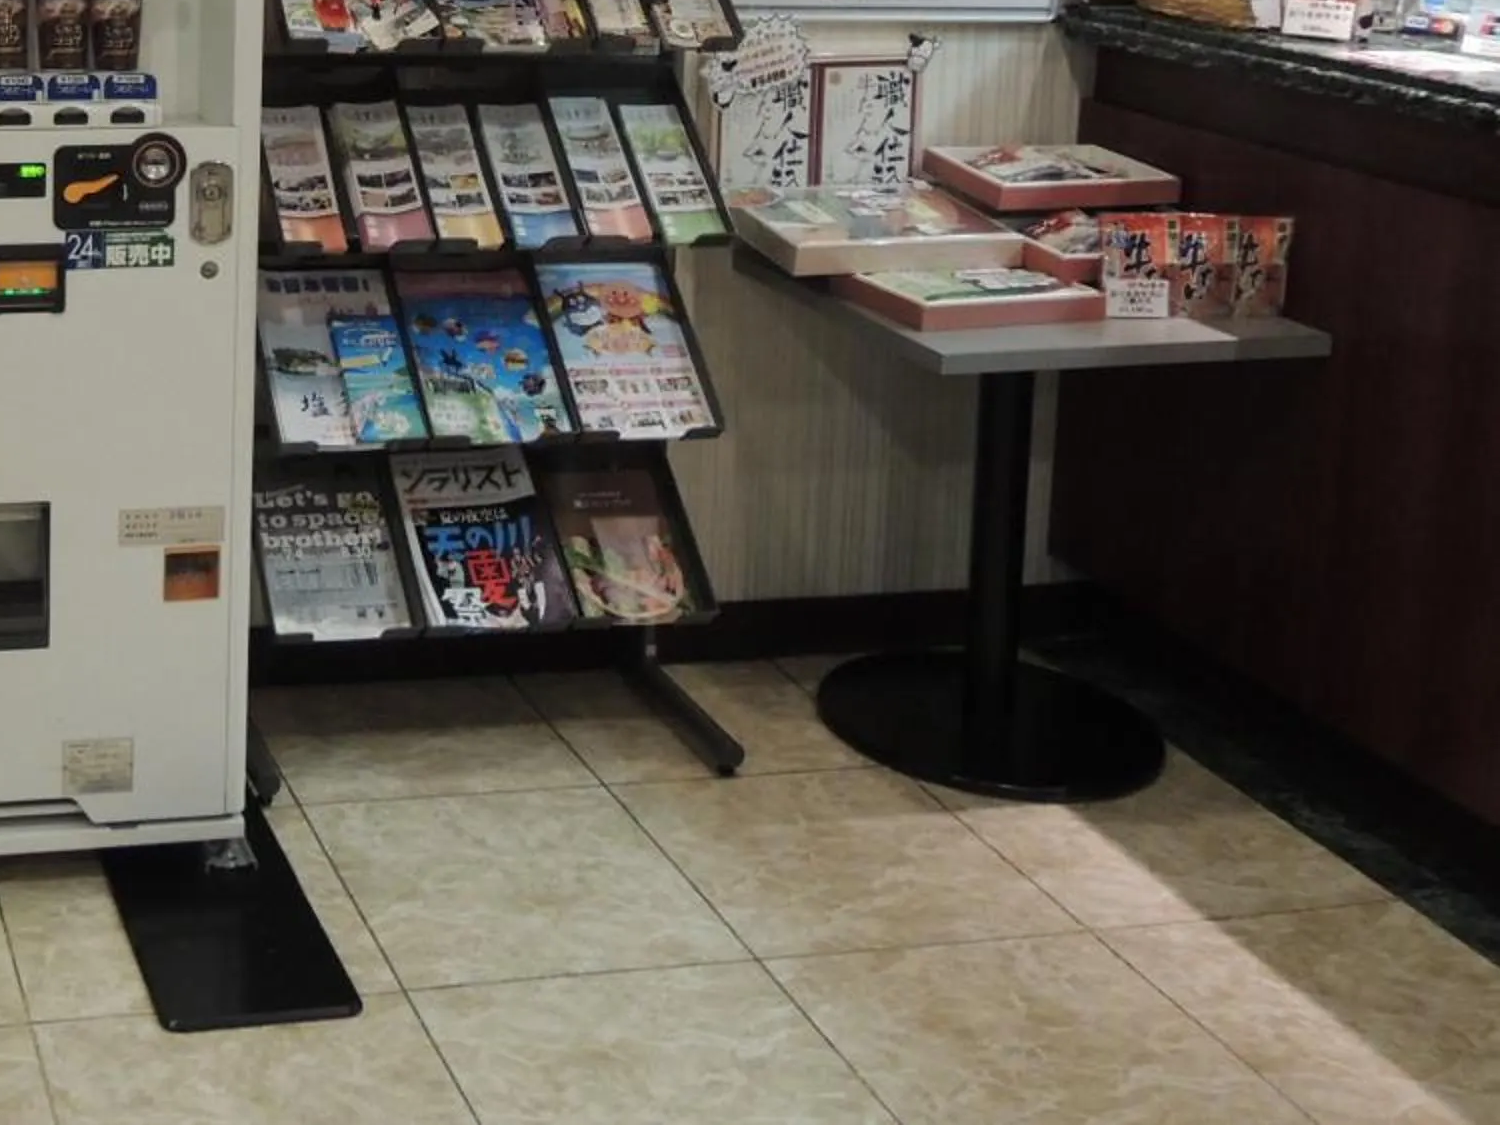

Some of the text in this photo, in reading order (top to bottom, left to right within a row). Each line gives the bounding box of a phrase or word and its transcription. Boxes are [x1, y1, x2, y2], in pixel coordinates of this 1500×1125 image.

[106, 242, 172, 267] 販売中
[401, 460, 522, 494] ソラリスト
[254, 489, 329, 509] Let's
[257, 512, 287, 529] to
